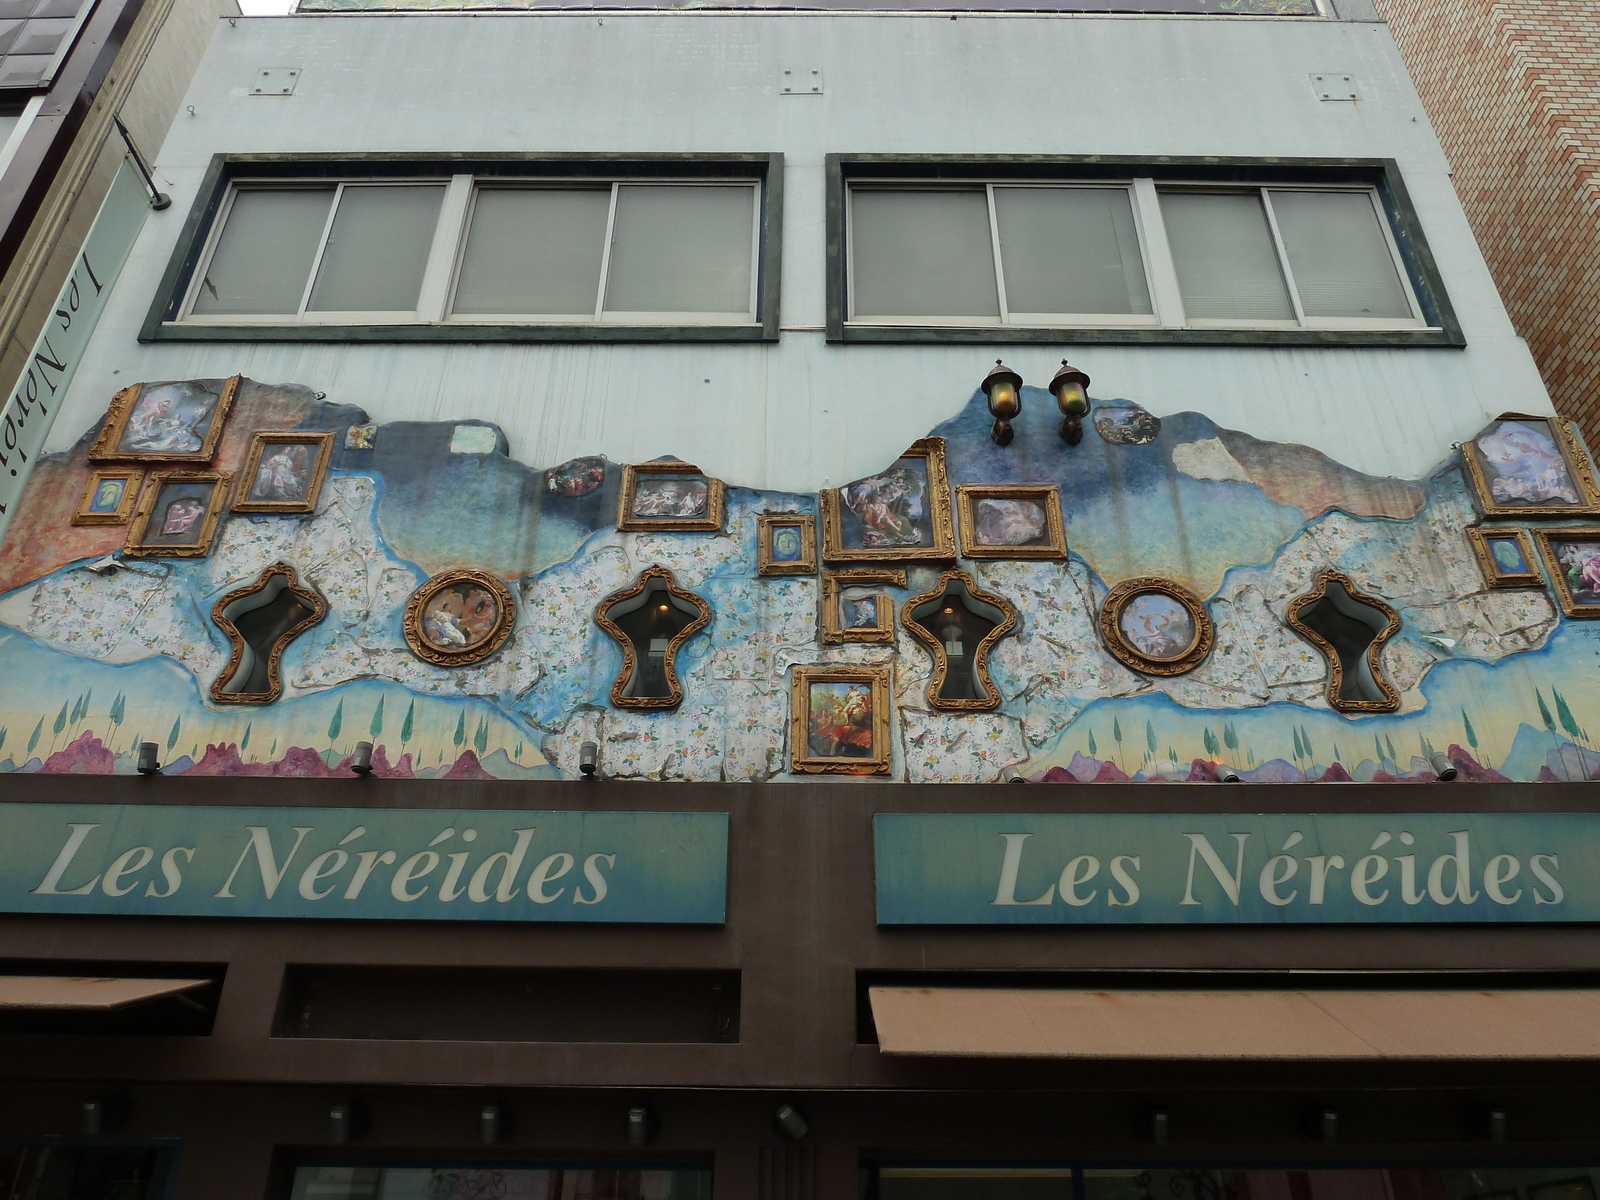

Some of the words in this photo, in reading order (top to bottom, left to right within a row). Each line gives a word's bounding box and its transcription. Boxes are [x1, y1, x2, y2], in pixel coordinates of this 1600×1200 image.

[31, 822, 197, 898] Les
[215, 825, 617, 905] Néréides
[990, 832, 1143, 907] Les
[1179, 830, 1565, 907] Néréides
